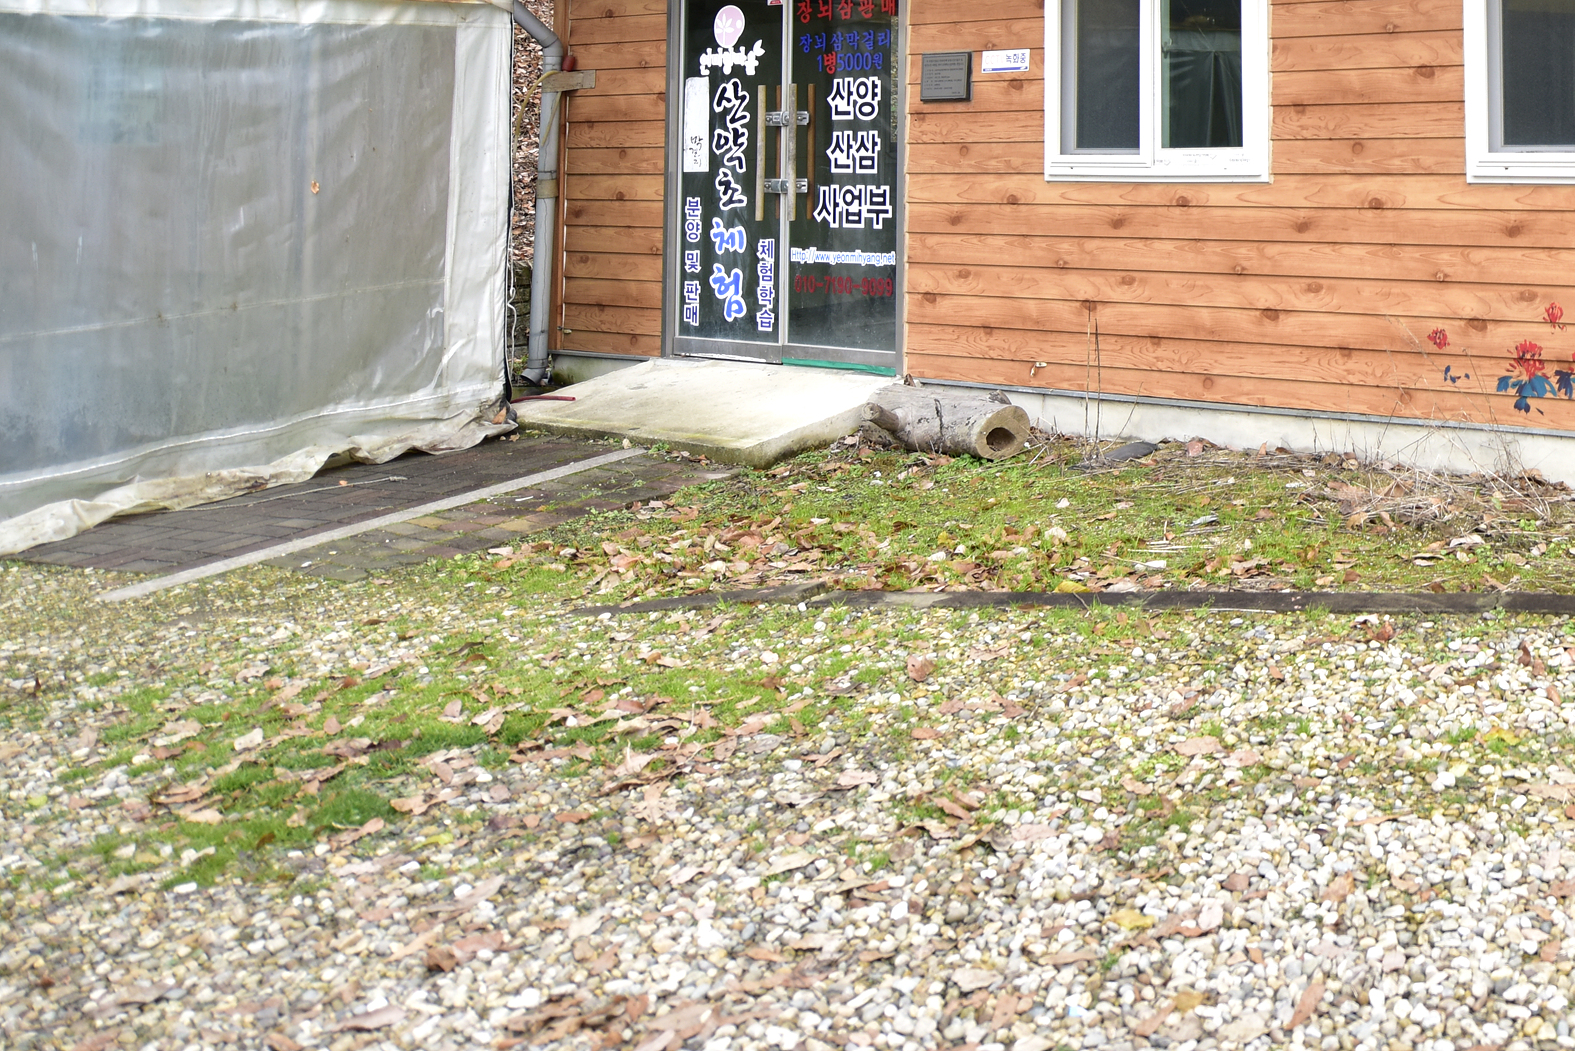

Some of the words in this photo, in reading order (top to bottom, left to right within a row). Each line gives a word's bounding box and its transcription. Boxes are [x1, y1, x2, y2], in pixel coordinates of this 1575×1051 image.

[799, 29, 890, 53] 장뇌삼막걸리
[827, 77, 881, 120] 산양
[826, 131, 881, 174] 산삼
[685, 197, 701, 242] 분양
[813, 185, 892, 229] 사업부
[685, 250, 701, 273] 및
[684, 281, 700, 326] 판매
[795, 274, 893, 296] 010-7190-9099
